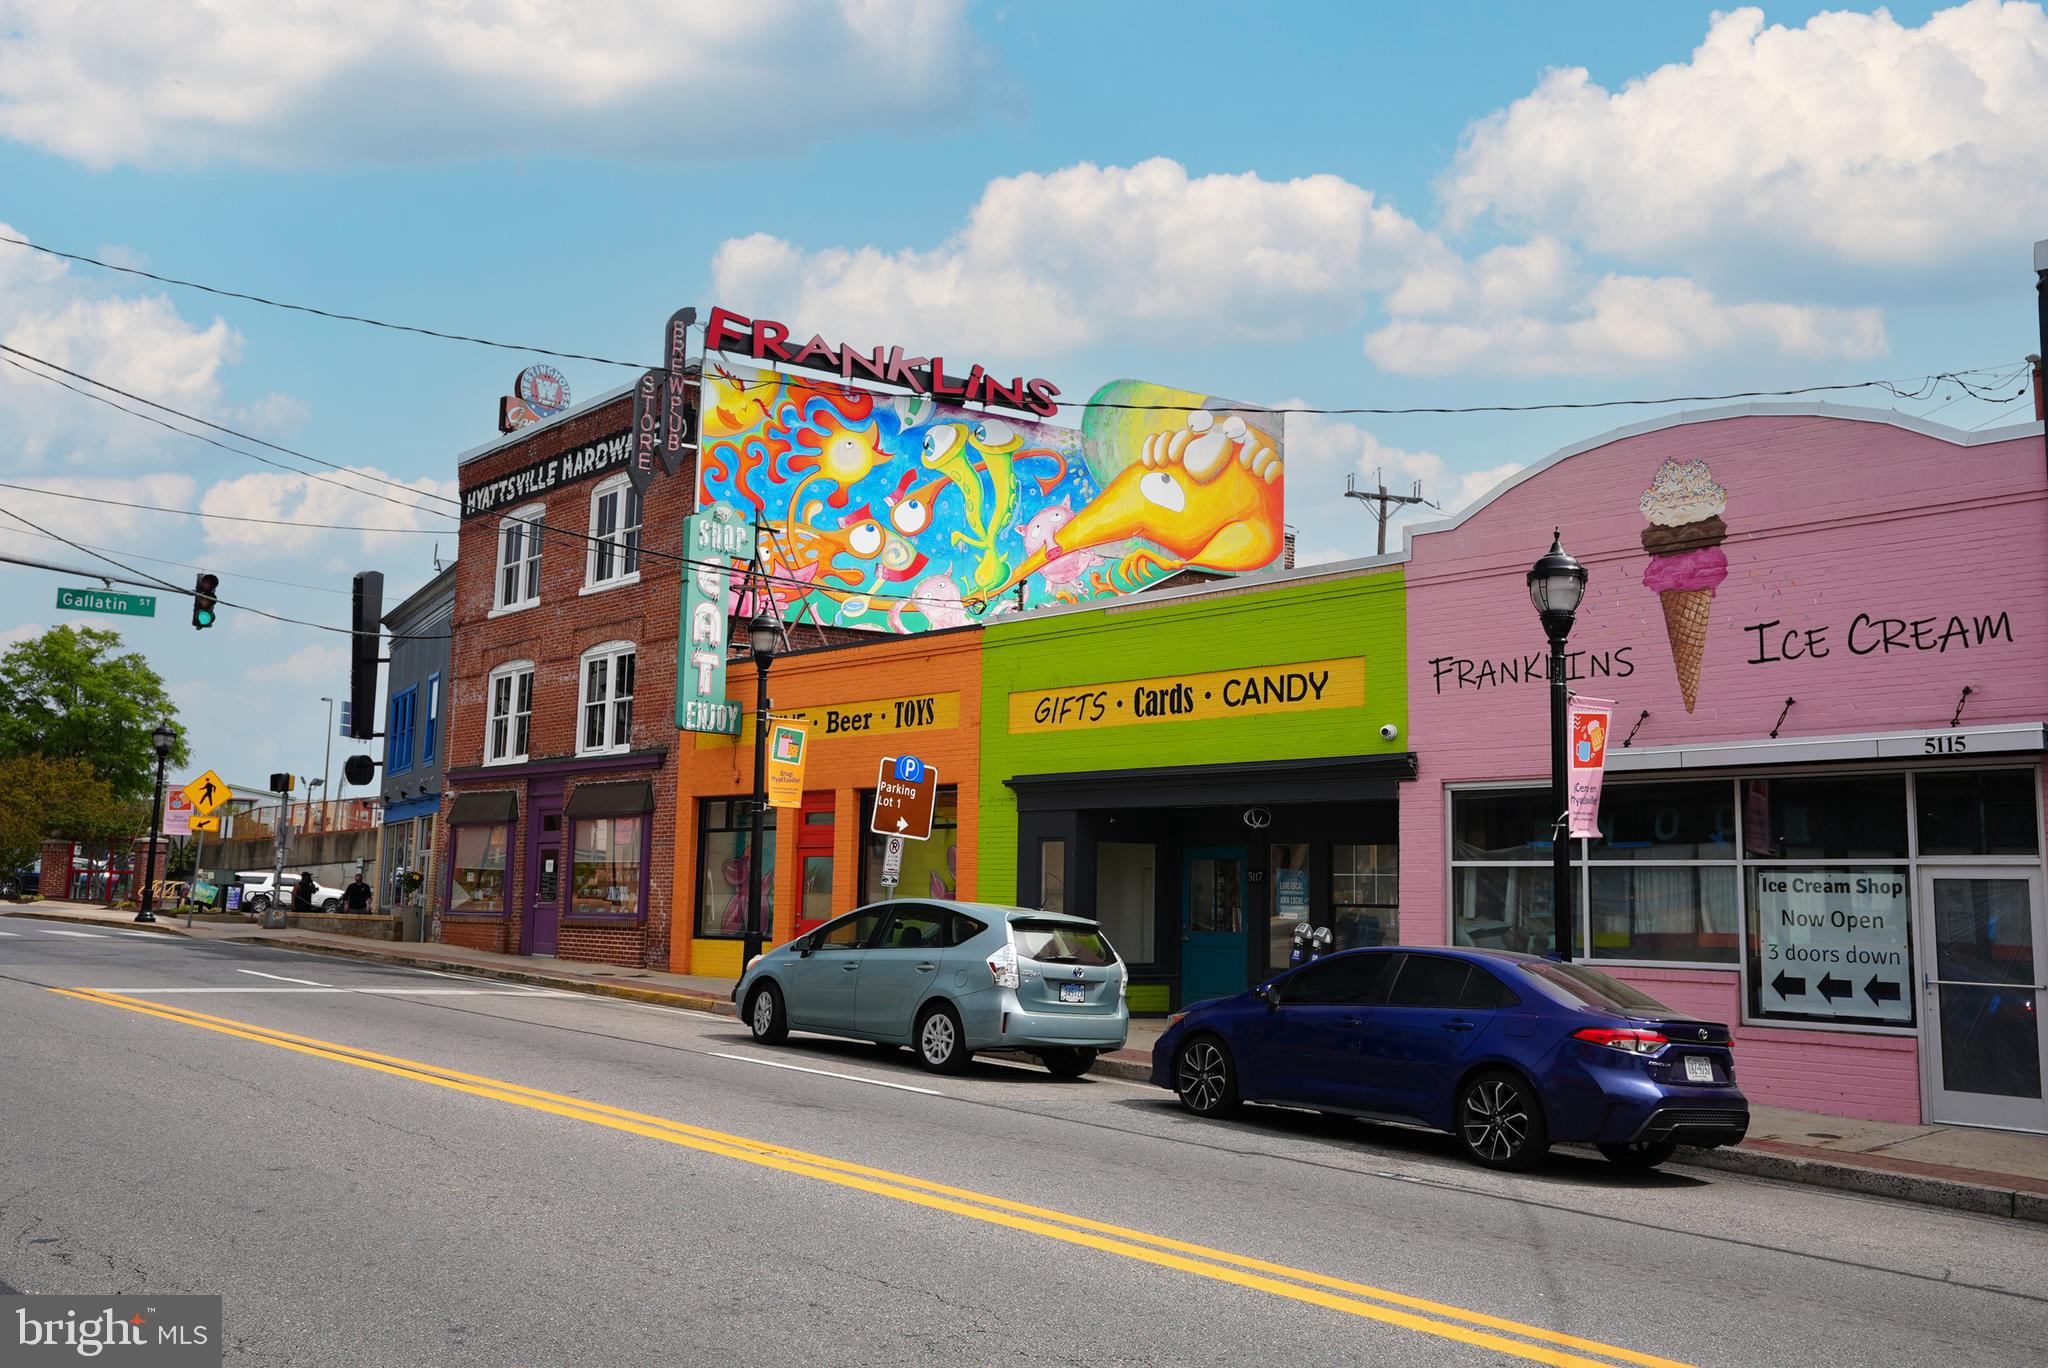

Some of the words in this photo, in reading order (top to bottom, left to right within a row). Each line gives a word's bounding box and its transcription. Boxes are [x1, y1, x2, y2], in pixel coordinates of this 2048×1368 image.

[522, 365, 570, 409] WESTINGHOUSE
[667, 320, 685, 451] BREWPUB
[638, 375, 656, 470] STORE
[466, 461, 558, 515] HYATTSVILLE
[562, 425, 656, 480] HARDWA
[699, 519, 748, 553] SHOP
[62, 593, 127, 610] Gallatin
[139, 598, 151, 606] ST
[691, 557, 724, 697] EAT
[1034, 691, 1109, 724] GIFTS
[1134, 683, 1194, 717] Cards
[1223, 671, 1329, 706] CANDY
[685, 701, 739, 732] ENJOY
[825, 711, 873, 734] Beer
[894, 698, 934, 728] TOYS
[1925, 736, 1966, 753] 5115
[879, 796, 893, 808] Lot
[896, 799, 901, 808] 1
[880, 781, 916, 799] Parking
[1248, 872, 1263, 882] 5117
[1762, 877, 1787, 893] Ice
[1792, 878, 1850, 894] Cream
[1856, 878, 1903, 898] Shop
[1782, 910, 1825, 927] Now
[1830, 910, 1884, 932] Open
[1768, 944, 1779, 960] 3
[1785, 944, 1840, 963] doors
[1846, 945, 1901, 965] down
